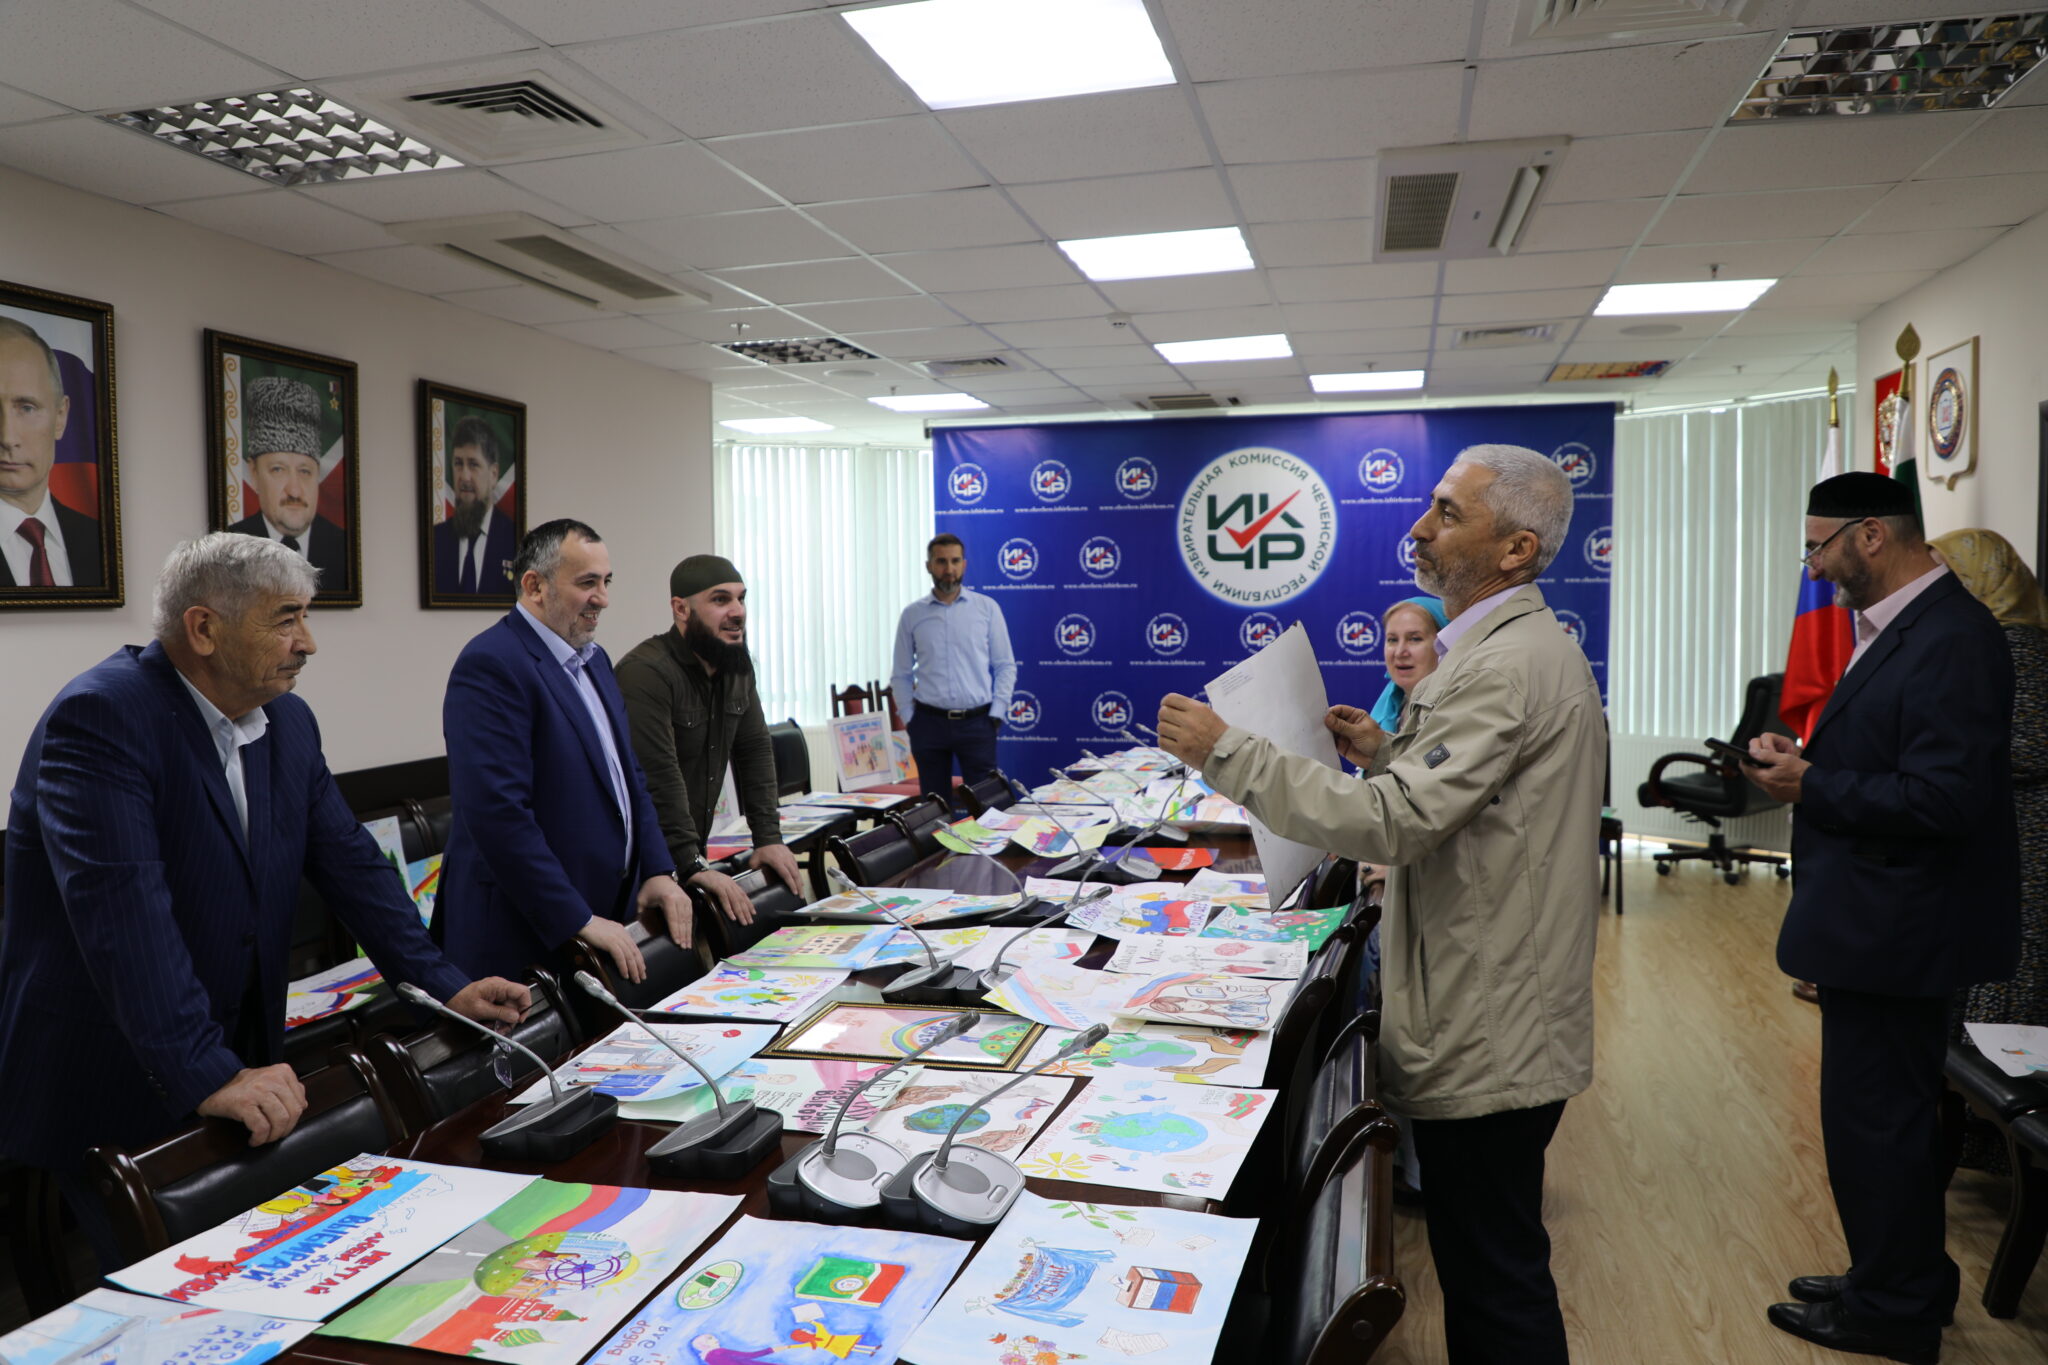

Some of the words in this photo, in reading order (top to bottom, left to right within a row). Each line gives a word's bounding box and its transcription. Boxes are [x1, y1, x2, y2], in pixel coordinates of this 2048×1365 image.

[1229, 453, 1309, 481] КОМИССИЯ
[1184, 465, 1224, 579] ИЗБИРАТЕЛЬНАЯ
[1207, 493, 1304, 530] ИК
[1307, 483, 1331, 572] ЧЕЧЕНСКОЙ
[1207, 533, 1305, 570] ЧР
[1213, 573, 1308, 602] РЕСПУБЛИКИ
[240, 1215, 374, 1282] ВЫБИРАЙ
[267, 1254, 330, 1289] ДУМАЙ
[304, 1250, 391, 1295] МЕЧТАЙ
